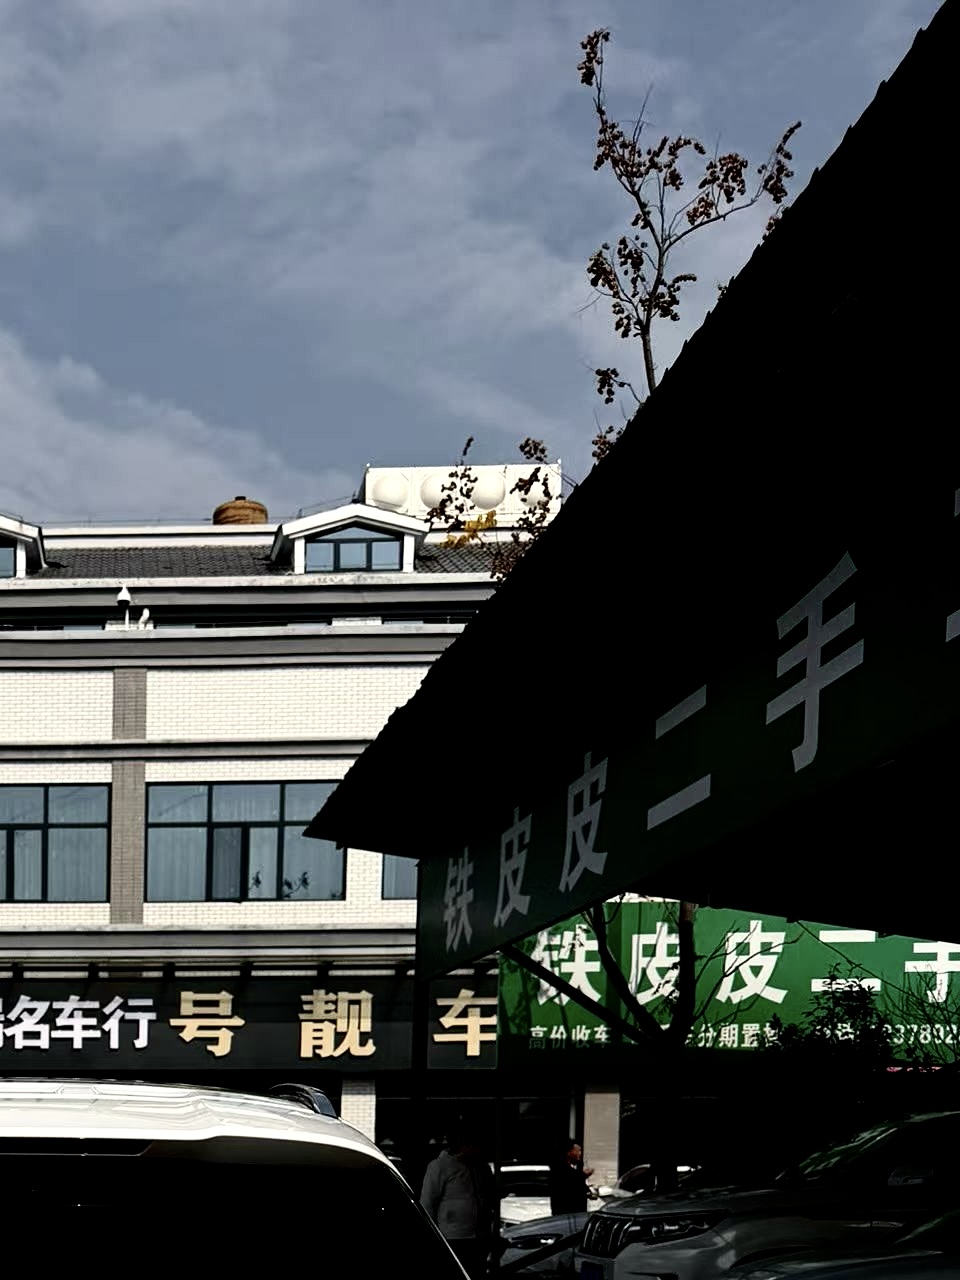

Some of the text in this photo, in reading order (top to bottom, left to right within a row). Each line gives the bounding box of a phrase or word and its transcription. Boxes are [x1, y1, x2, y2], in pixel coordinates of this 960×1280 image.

[442, 488, 960, 952] 铁皮皮二手
